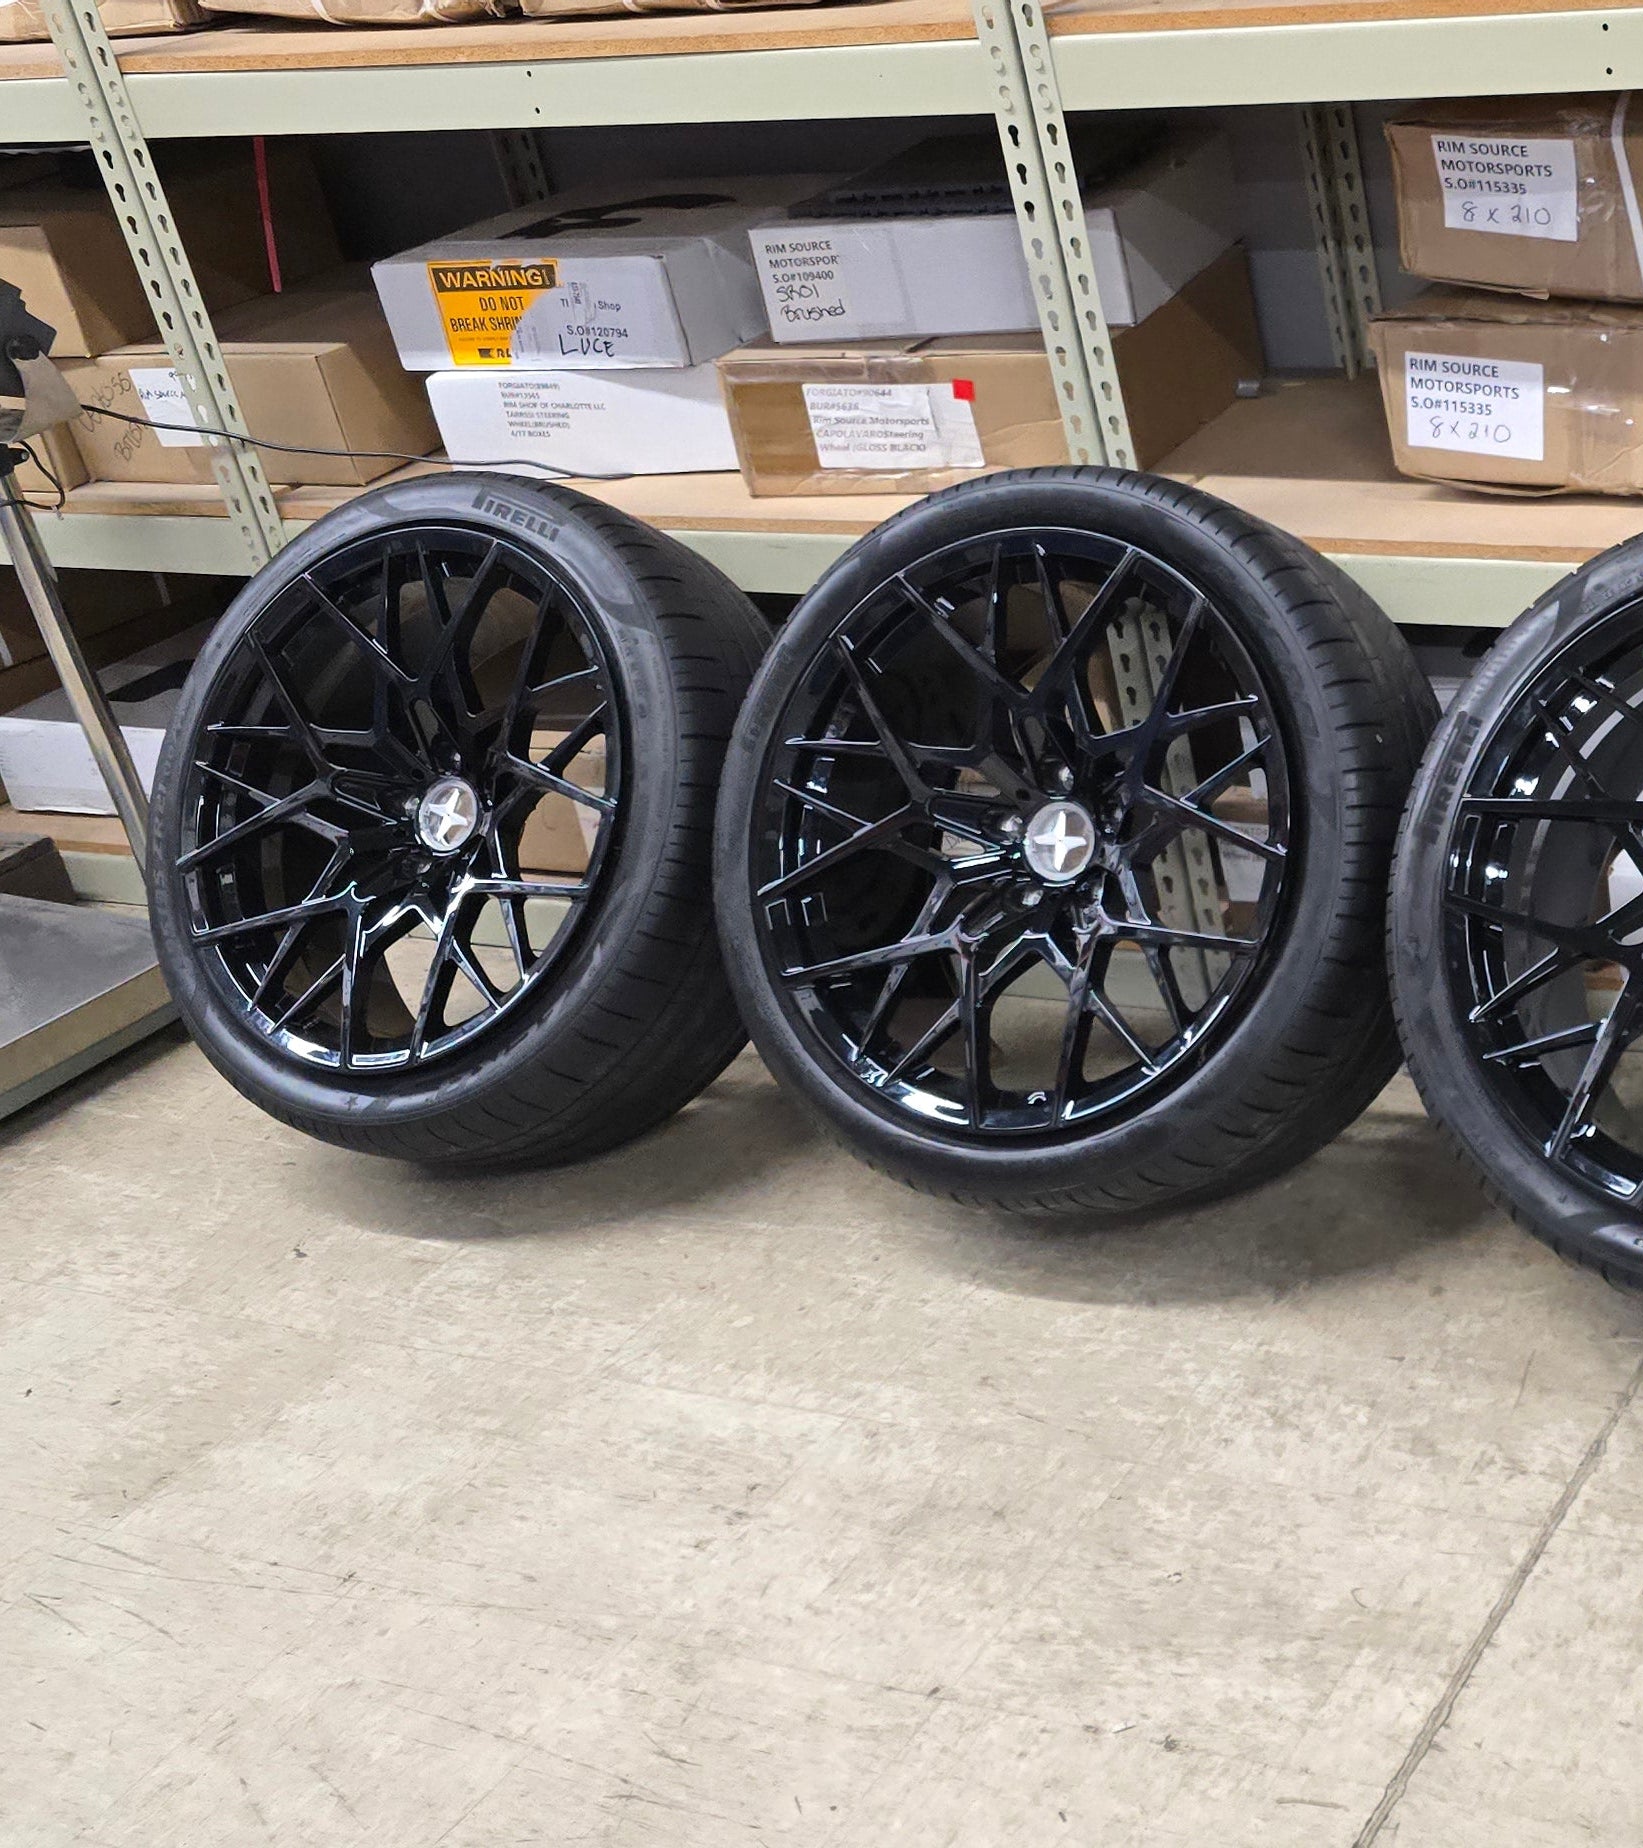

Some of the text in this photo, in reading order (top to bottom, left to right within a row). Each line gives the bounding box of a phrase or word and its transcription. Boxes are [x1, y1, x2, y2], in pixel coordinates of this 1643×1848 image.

[1437, 141, 1529, 158] RIM SOURCE
[1441, 160, 1552, 177] MOTORSPORTS
[1444, 177, 1527, 195] S.O#115335
[1462, 201, 1478, 222] 8
[1511, 204, 1551, 226] 210
[765, 241, 833, 254] RIM SOURCE
[769, 255, 840, 269] MOTORSPOR
[773, 271, 834, 284] S.O#109400
[479, 296, 525, 312] DO NOT
[598, 300, 622, 312] Shop
[781, 298, 846, 322] Brushed
[450, 317, 489, 332] BREAK
[558, 333, 616, 358] LUCE
[1409, 358, 1499, 378] RIM SOURCE
[1410, 377, 1520, 400] MOTORSPORTS
[1411, 396, 1492, 416] S.O#115335
[813, 416, 930, 426] Rim Source Motorsports
[1429, 415, 1445, 439] 8
[1468, 422, 1512, 443] 210
[819, 443, 850, 452] Wheel
[471, 487, 562, 542] PIRELLI
